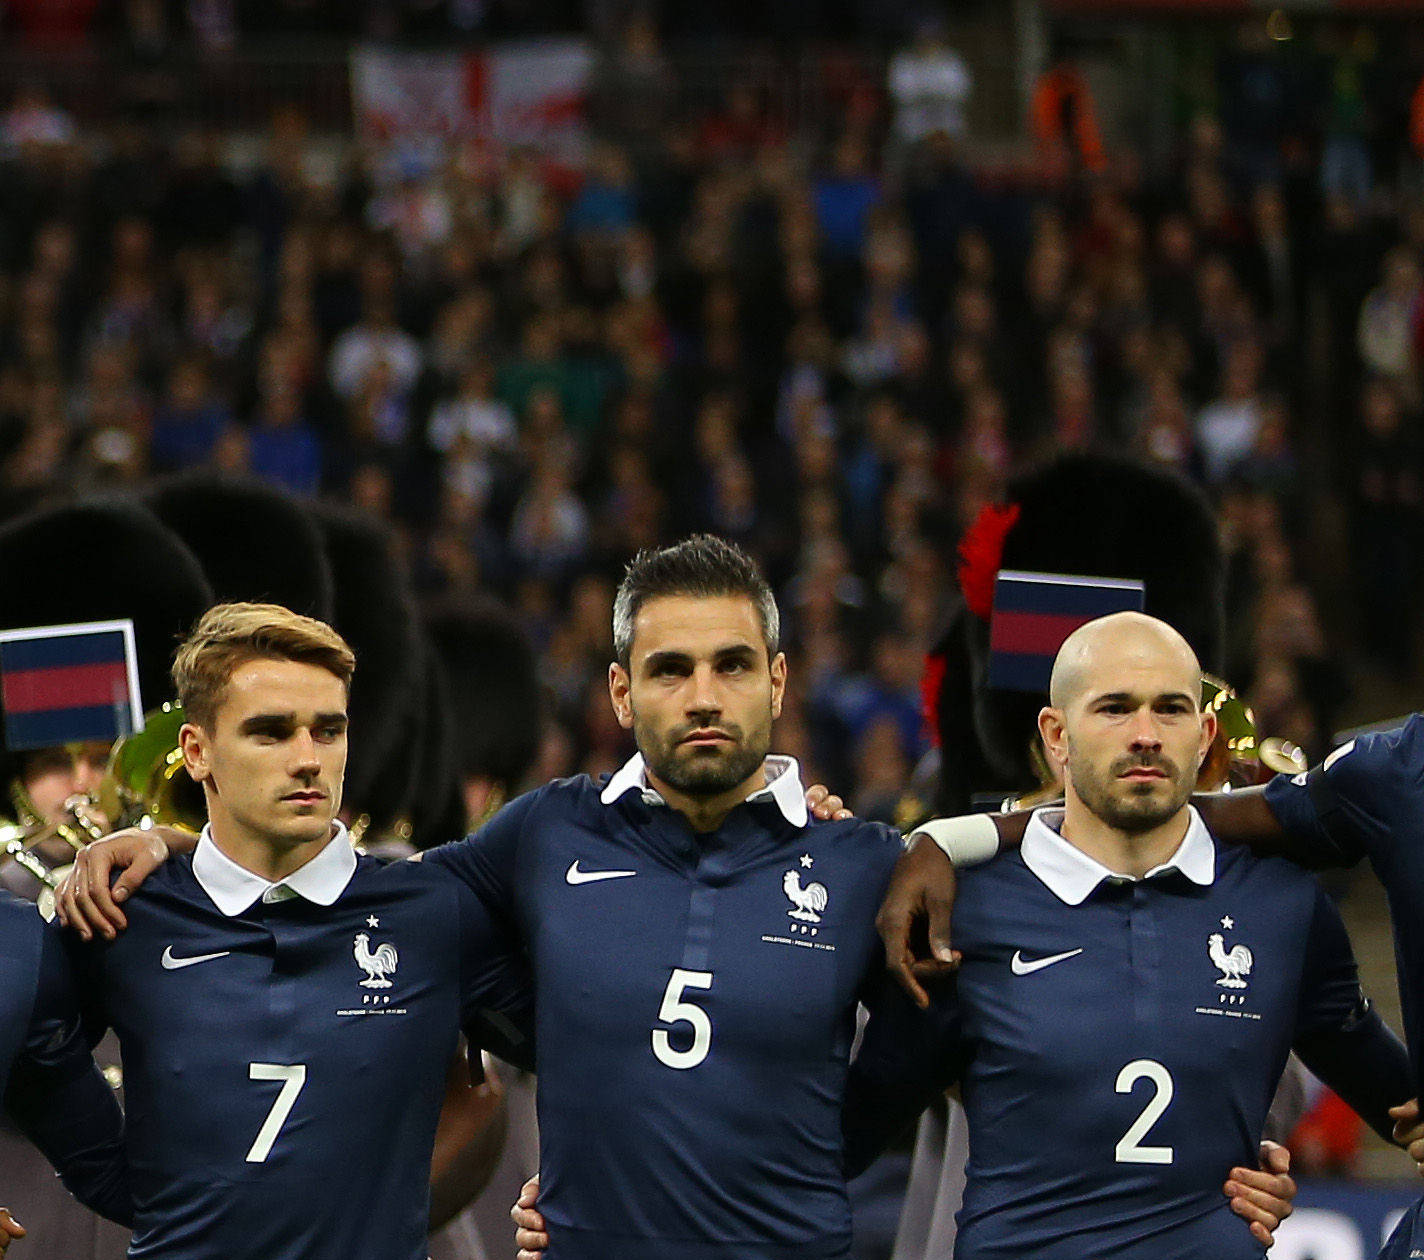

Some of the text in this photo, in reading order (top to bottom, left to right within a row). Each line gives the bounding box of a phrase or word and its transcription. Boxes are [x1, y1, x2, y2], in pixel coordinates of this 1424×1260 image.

[650, 968, 714, 1069] 5
[245, 1061, 307, 1163] 7
[1114, 1058, 1174, 1164] 2
